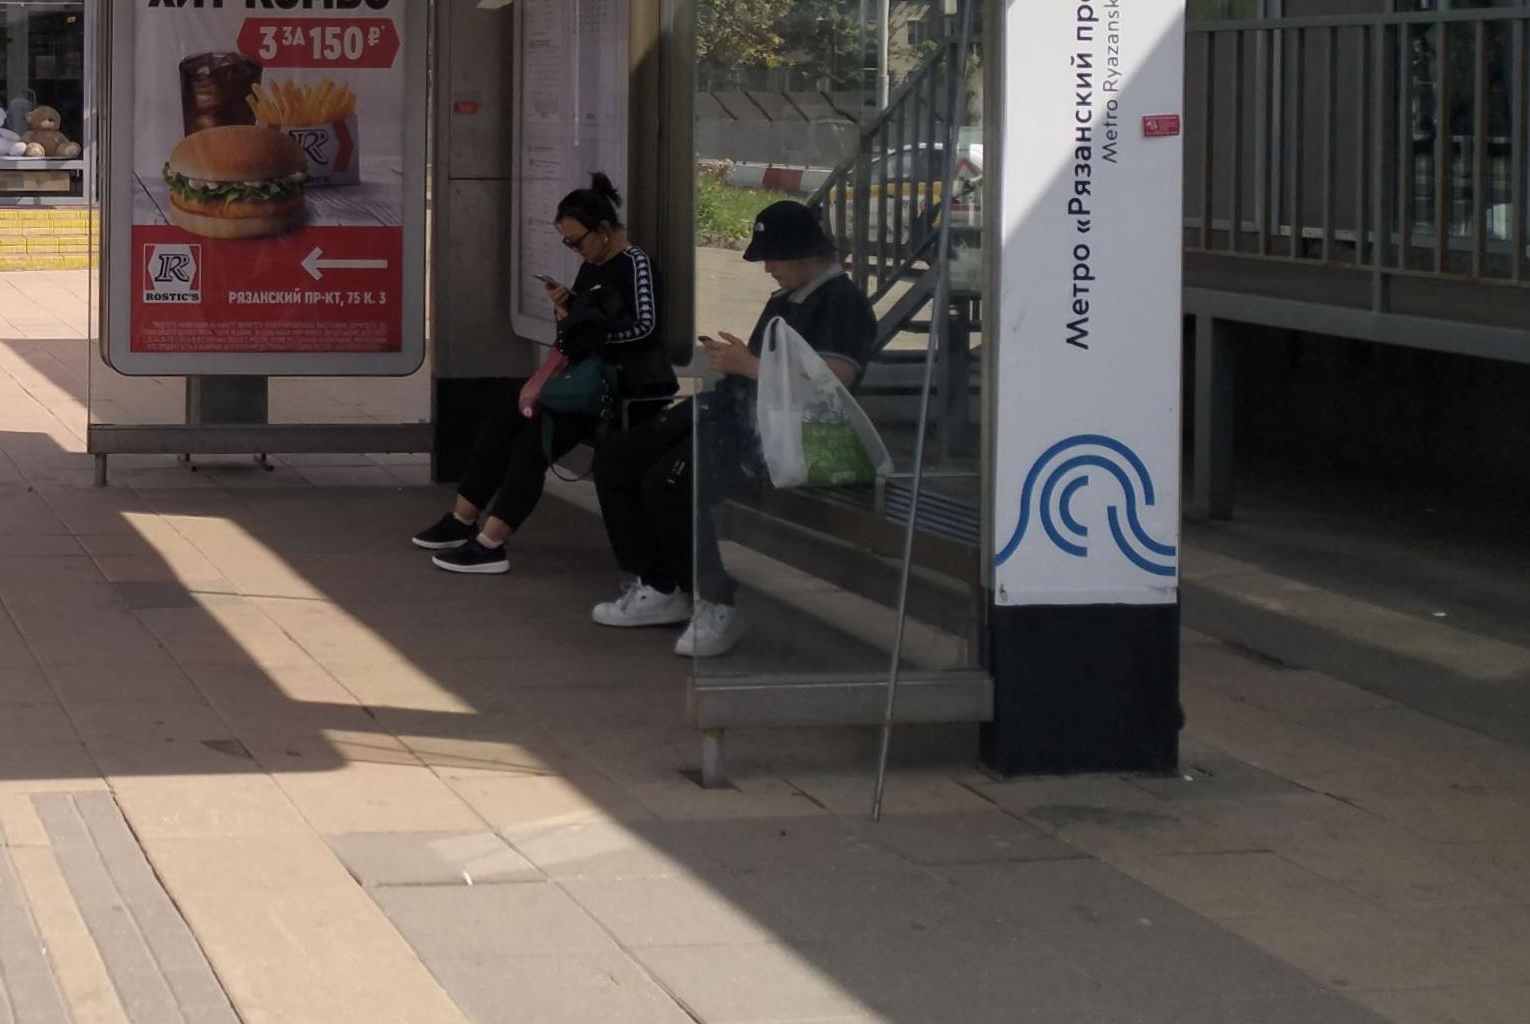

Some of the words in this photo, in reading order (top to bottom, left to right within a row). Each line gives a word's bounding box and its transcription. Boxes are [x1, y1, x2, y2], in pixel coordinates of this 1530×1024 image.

[257, 26, 277, 60] 3
[309, 26, 363, 60] 150
[1068, 52, 1093, 234] «Рязанский
[1101, 98, 1119, 164] Metro
[145, 292, 200, 302] ROSTIC'S
[228, 287, 301, 305] РЯЗАНСКИЙ
[304, 291, 344, 308] ПР-КТ,
[346, 291, 361, 305] 75
[364, 291, 375, 305] К.
[379, 291, 387, 305] 3
[1065, 243, 1096, 350] Метро
